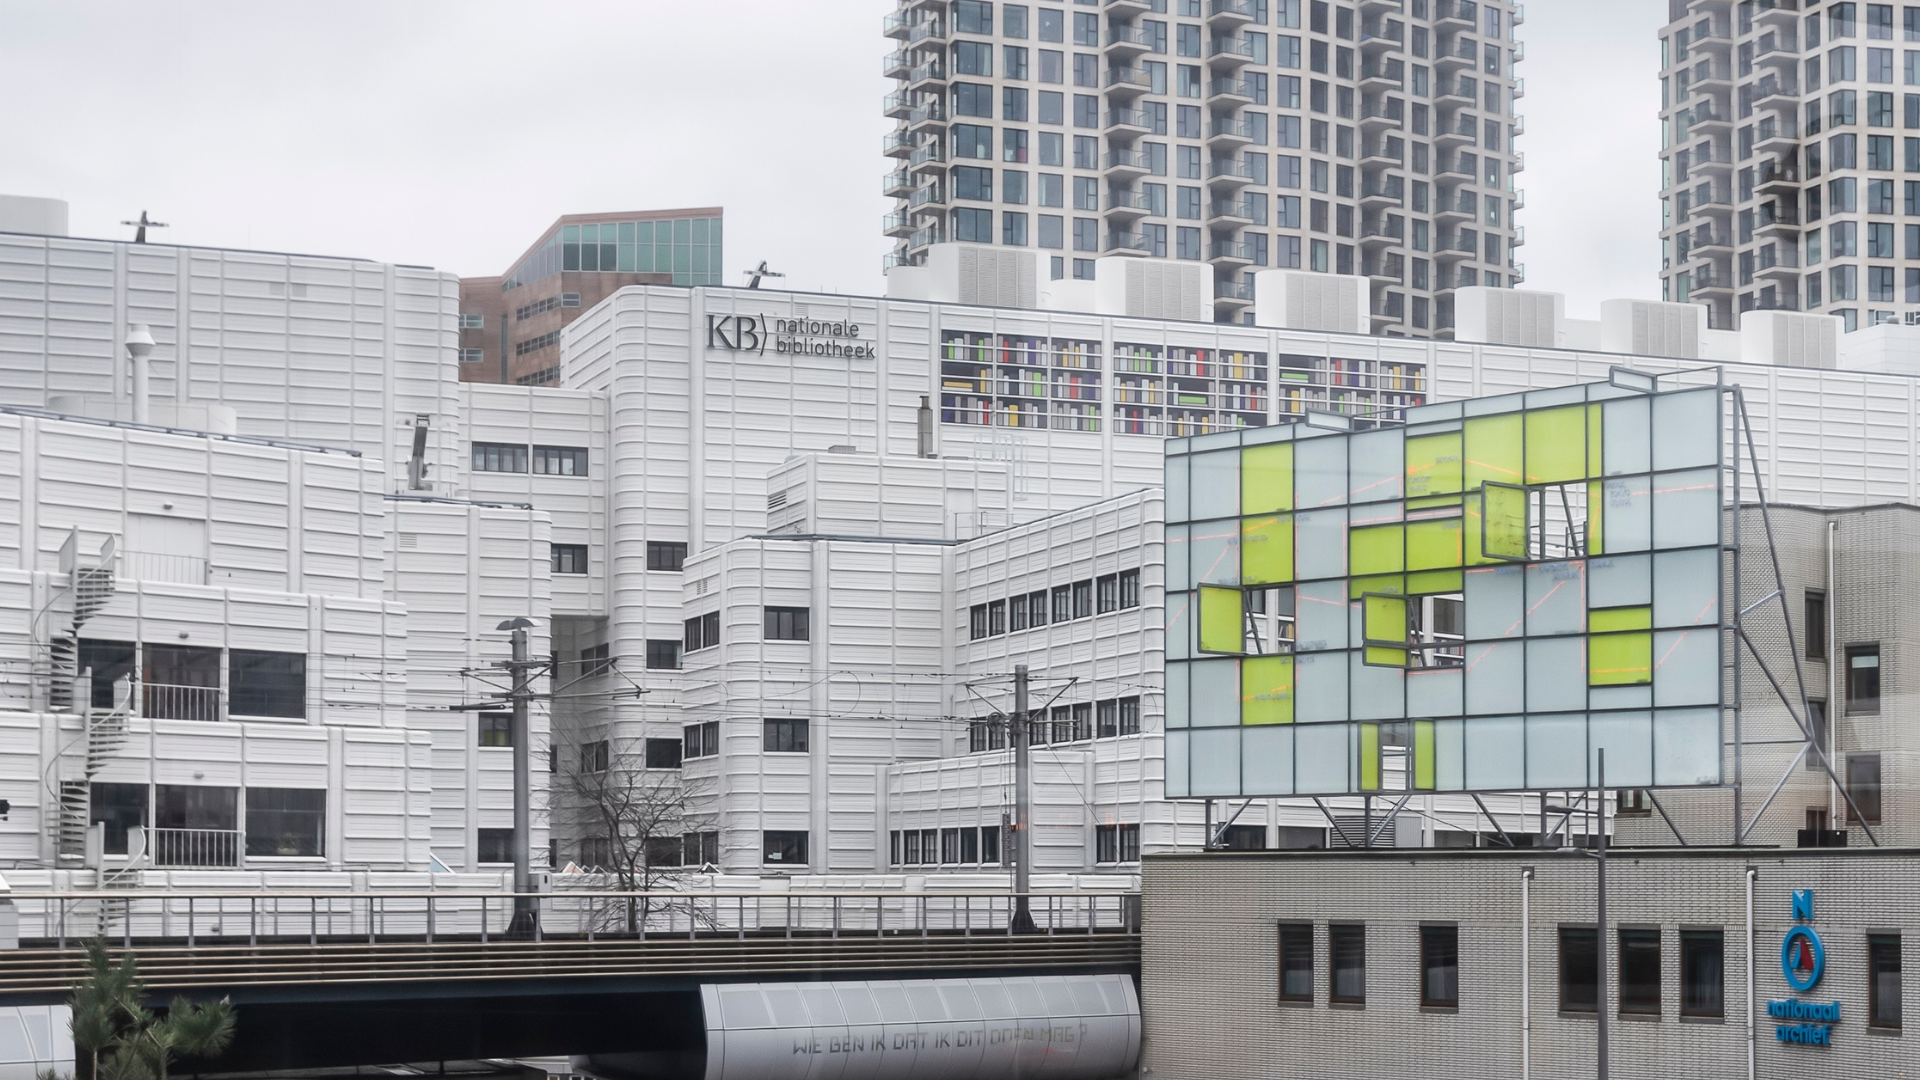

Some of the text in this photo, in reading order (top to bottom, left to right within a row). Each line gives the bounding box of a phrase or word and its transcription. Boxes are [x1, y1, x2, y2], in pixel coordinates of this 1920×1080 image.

[776, 316, 860, 337] nationale
[775, 335, 876, 359] bibliotheek
[1766, 997, 1841, 1021] nationaal
[793, 1036, 823, 1055] WIE
[870, 1034, 886, 1052] IK
[893, 1032, 928, 1050] DAT
[935, 1031, 951, 1049] IK
[956, 1029, 984, 1048] DIT
[1775, 1023, 1833, 1045] archief
